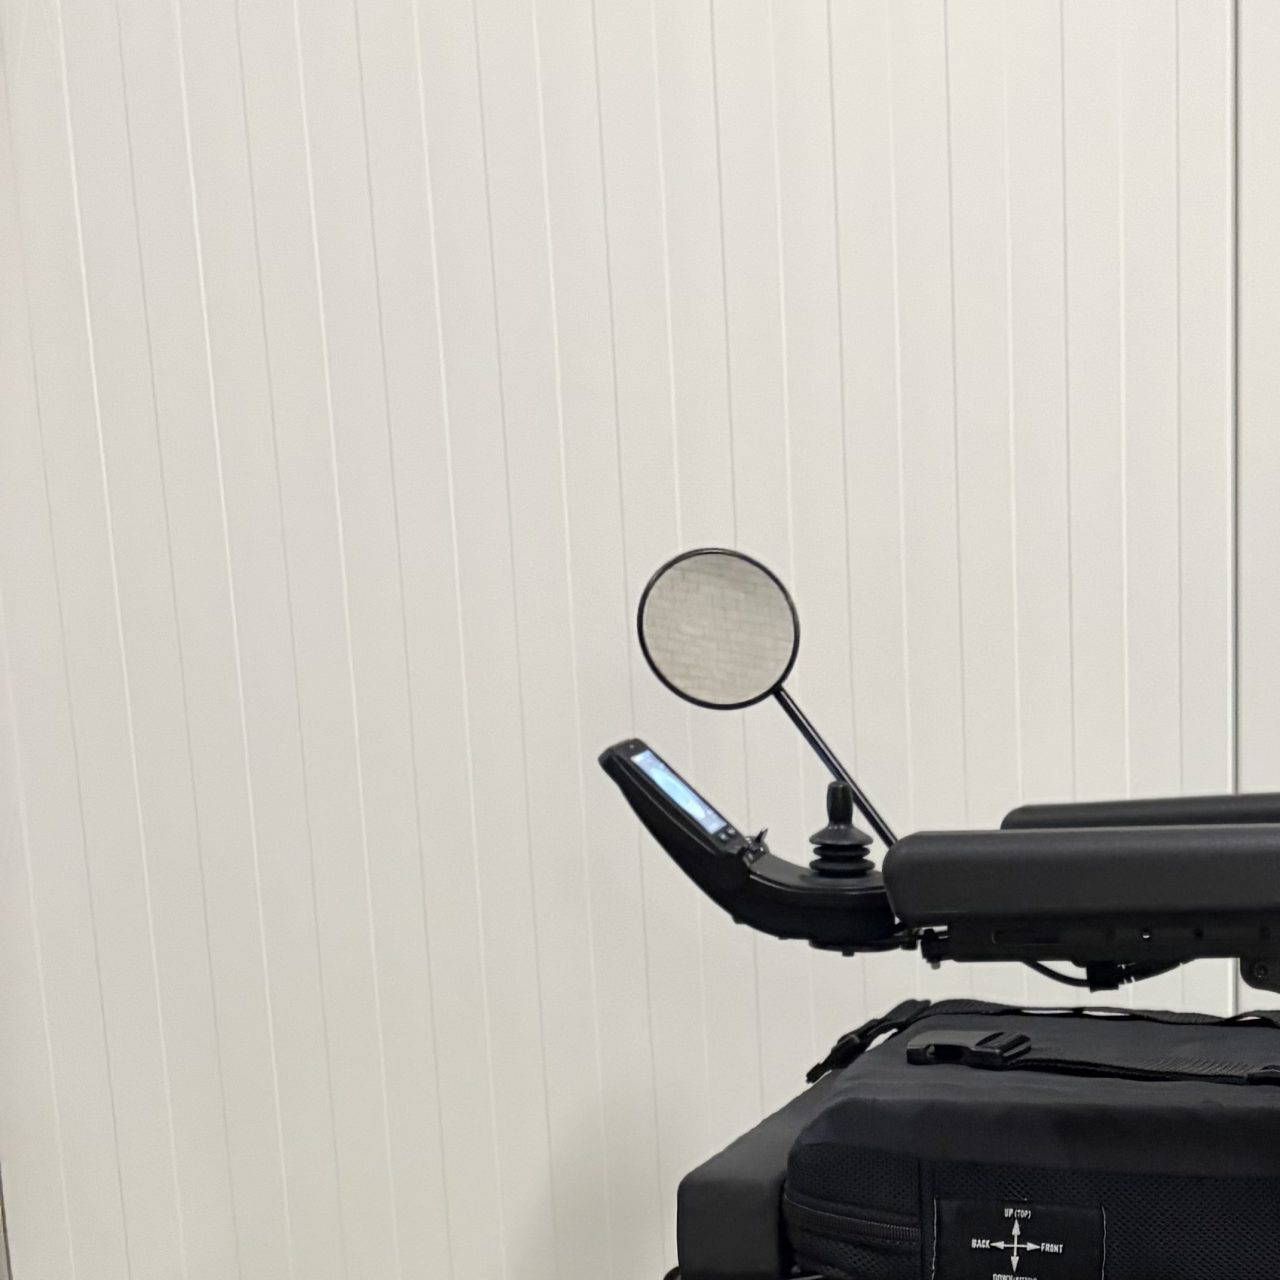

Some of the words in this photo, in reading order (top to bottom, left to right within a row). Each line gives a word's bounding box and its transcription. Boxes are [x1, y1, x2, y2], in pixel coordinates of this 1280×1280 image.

[1004, 1208, 1013, 1218] UP
[971, 1238, 990, 1249] BACK
[1040, 1242, 1063, 1254] FRONT
